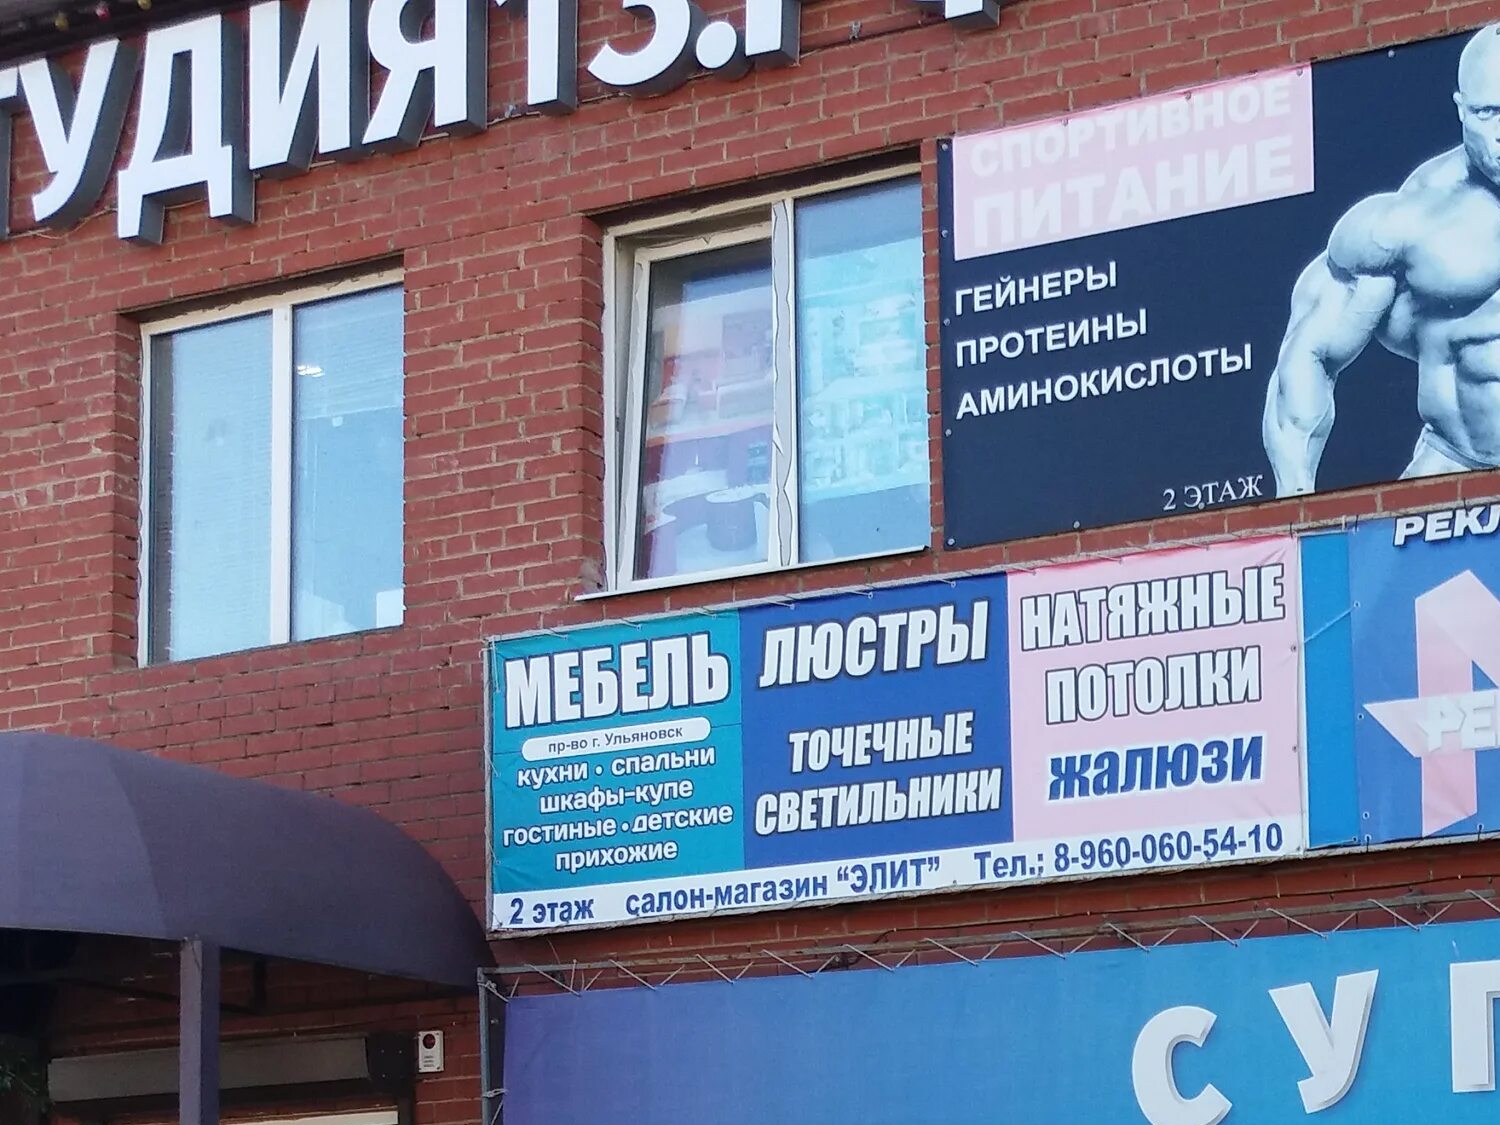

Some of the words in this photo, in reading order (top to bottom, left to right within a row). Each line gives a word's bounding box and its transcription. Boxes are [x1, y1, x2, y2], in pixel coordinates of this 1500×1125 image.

[971, 77, 1292, 177] СПОРТИВНОЕ
[973, 136, 1294, 249] ПИТАНИЕ
[955, 261, 1117, 316] ГЕЙНЕРЫ
[956, 308, 1147, 367] ПРОТЕИНЫ
[956, 343, 1252, 419] АМИНОКИСЛОТЫ
[1163, 488, 1176, 510] 2
[1184, 474, 1263, 508] ЭТАЖ
[1020, 563, 1286, 652] НАТЯЖНЫЕ
[759, 600, 989, 689] ЛЮСТРЫ
[504, 631, 731, 729] МЕБЕЛЬ
[1045, 645, 1262, 725] ПОТОЛКИ
[517, 761, 589, 790] кухни
[611, 746, 716, 777] спальни
[548, 739, 588, 754] пр-во
[592, 736, 600, 748] г.
[605, 726, 683, 746] Ульяновск
[788, 710, 974, 774] ТОЧЕЧНЫЕ
[503, 817, 617, 848] гостиные
[632, 803, 734, 834] детские
[540, 778, 694, 815] шкафы-купе
[754, 766, 1003, 837] СВЕТИЛЬНИКИ
[510, 897, 523, 924] 2
[532, 898, 594, 923] этаж
[1055, 822, 1283, 873] 8-960-060-54-10
[555, 840, 679, 874] прихожие
